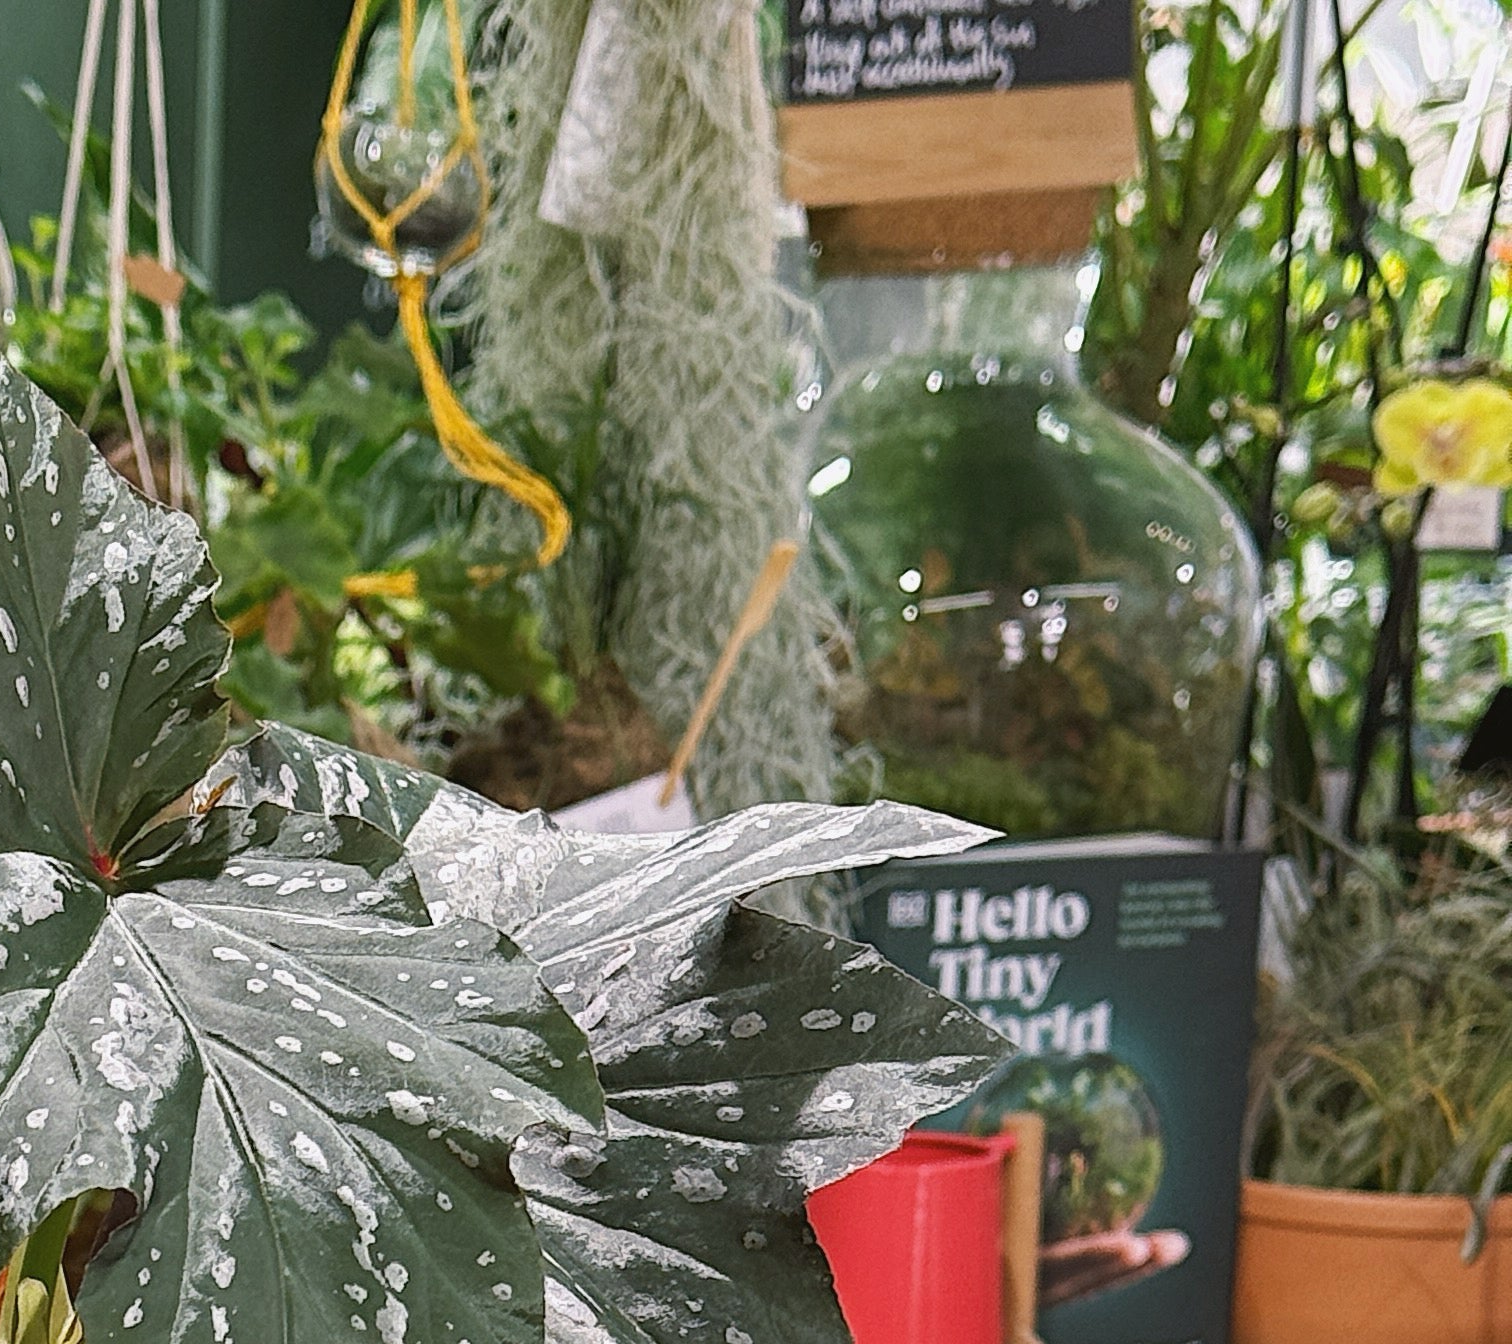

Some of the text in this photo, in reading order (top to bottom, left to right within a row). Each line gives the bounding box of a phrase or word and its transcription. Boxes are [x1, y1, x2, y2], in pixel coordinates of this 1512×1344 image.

[933, 885, 1088, 943] Hello
[929, 945, 1061, 1009] Tiny
[980, 1000, 1112, 1056] orld
